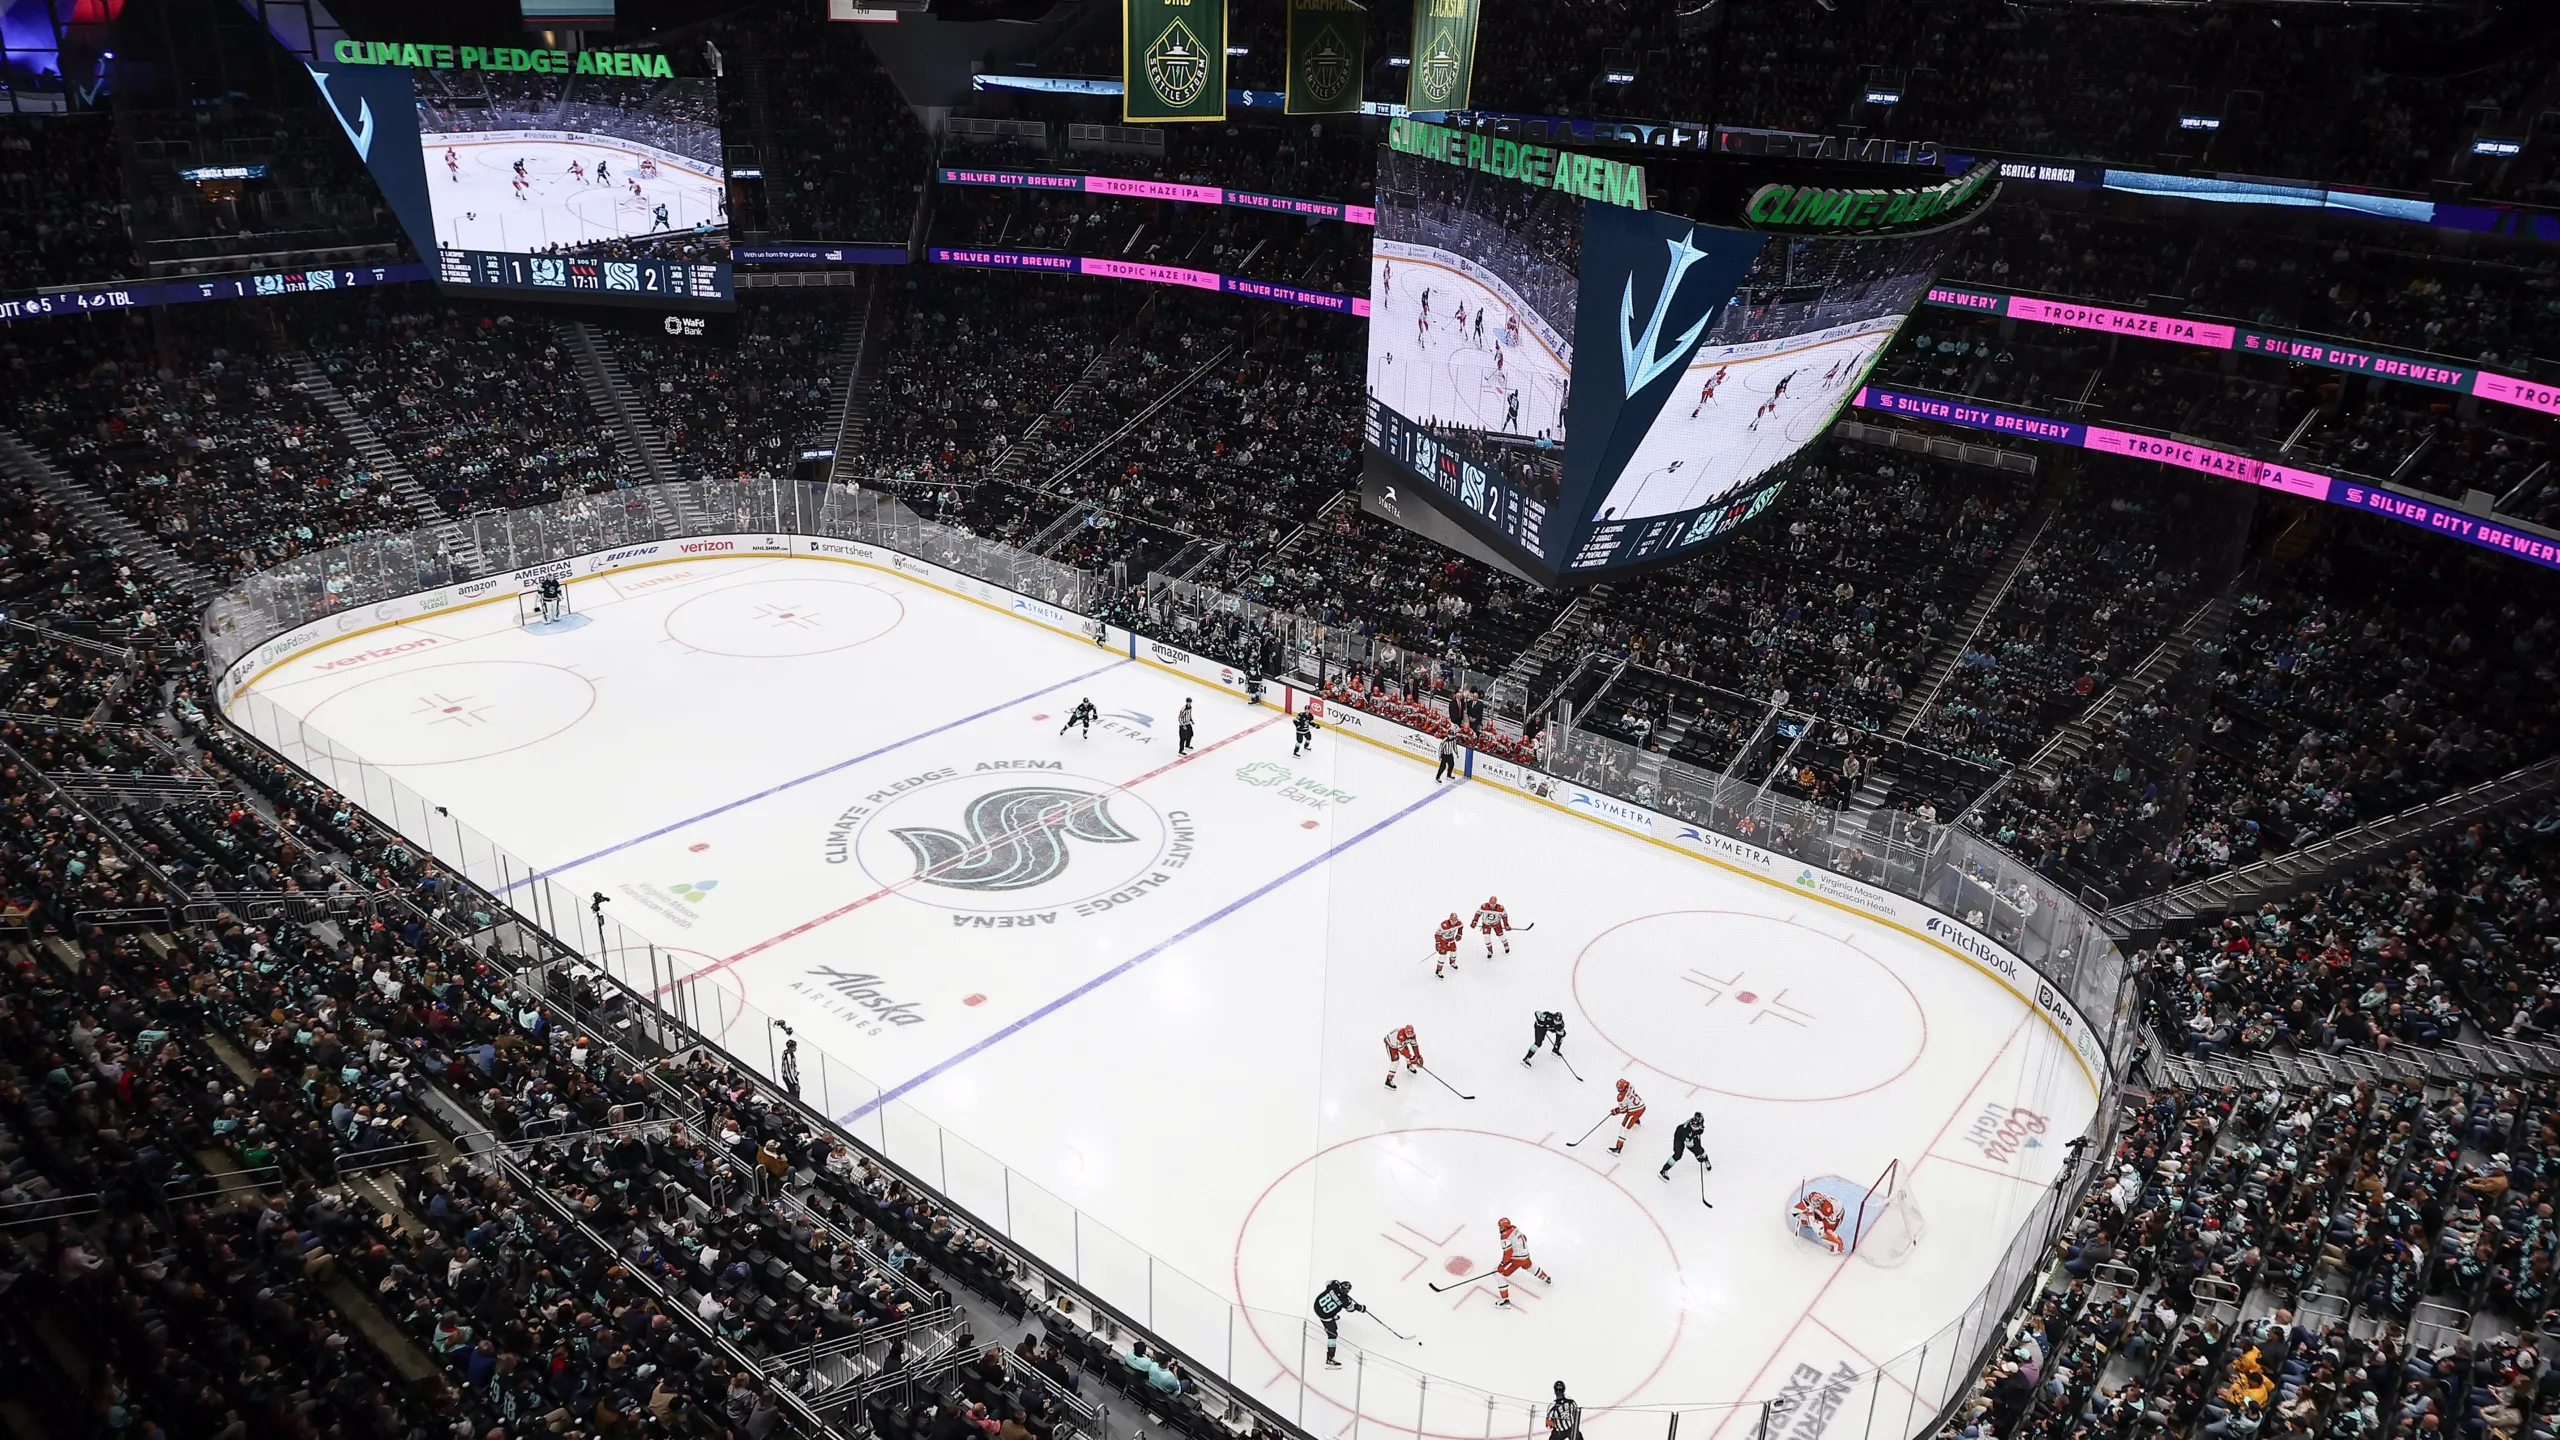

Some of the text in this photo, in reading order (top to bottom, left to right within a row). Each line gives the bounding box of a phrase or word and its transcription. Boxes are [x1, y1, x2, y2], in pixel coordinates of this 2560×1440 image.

[333, 39, 674, 79] CLIMATE PLEDGE ARENA
[1150, 58, 1206, 101] SEATTLE STORM
[1388, 117, 1645, 211] CLIMATE PLEDGE ARENA
[2000, 163, 2076, 183] SEATTLE KRAKEN
[960, 172, 1339, 217] SILVER CITY BREWERY TROPIC HAZE IPA SILVER CITY BREWERY
[1748, 182, 1888, 226] CLIMATE
[511, 261, 522, 283] 1
[590, 258, 597, 266] 17
[235, 281, 244, 296] 1
[286, 282, 307, 293] 17:11
[345, 272, 356, 286] 2
[571, 275, 599, 290] 17:11
[645, 268, 659, 291] 2
[953, 252, 1343, 308] SILVER CITY BREWERY TROPIC HAZE IPA SILVER CITY BREWERY
[40, 298, 52, 312] 5
[78, 295, 88, 308] 4
[106, 291, 134, 306] TBL
[682, 317, 705, 328] WaFd
[684, 326, 703, 336] Bank
[1927, 288, 1998, 310] BREWERY
[2043, 304, 2107, 328] TROPIC
[2112, 314, 2159, 335] HAZE
[2166, 321, 2195, 340] IPA
[2264, 338, 2323, 362] SILVER
[2328, 347, 2368, 370] CITY
[2373, 358, 2463, 387] BREWERY
[1405, 432, 1410, 462] 1
[1898, 397, 1949, 420] SILVER
[1954, 404, 1990, 427] CITY
[1995, 413, 2070, 439] BREWERY
[2128, 438, 2193, 465] TROPIC
[2199, 452, 2246, 476] HAZE
[2254, 464, 2284, 486] IPA
[2369, 492, 2426, 523] SILVER
[2433, 507, 2472, 533] CITY
[1439, 470, 1456, 497] 17:11
[1378, 494, 1401, 520] SYMETRA
[1488, 486, 1499, 522] 2
[1595, 534, 1614, 542] GUDAS
[1600, 525, 1627, 534] LACOMBE
[1665, 521, 1686, 549] 1
[606, 546, 660, 563] BOEING
[680, 539, 734, 554] verizon
[822, 542, 874, 560] smartsheet
[1590, 541, 1621, 551] COLANGELO
[1641, 539, 1656, 547] HITS
[892, 554, 930, 577] WatchGuard
[1571, 558, 1608, 568] 44 JOHNSTON
[1584, 550, 1612, 560] POEHLING
[514, 560, 572, 581] AMERICAN
[523, 569, 573, 588] EXPESS
[458, 579, 497, 595] amazon
[1027, 602, 1065, 623] SYMETRA
[313, 636, 438, 671] verizon
[1152, 642, 1190, 664] amazon
[241, 660, 255, 677] App
[1221, 672, 1234, 680] PEPSI
[1238, 677, 1267, 695] PSI
[1326, 706, 1362, 728] TOYOTA
[1482, 763, 1516, 779] KRAKEN
[1277, 786, 1330, 810] Bank
[1296, 776, 1357, 804] WaFd
[825, 758, 1064, 865] CLIMATE PLEDGE ARENA
[1594, 798, 1653, 827] SYMETRA
[1704, 834, 1771, 866] SYMETRA
[952, 809, 1195, 929] CLIMATE PLEDGE ARENA
[638, 880, 700, 920] Virginia Mason
[1818, 883, 1896, 917] Franciscan Health
[1820, 874, 1884, 903] Virginia Mason
[617, 883, 694, 930] Franciscan Health
[1940, 922, 2018, 981] PitchBook
[804, 964, 926, 1027] Alaska
[787, 981, 883, 1037] AIRLINES
[2052, 1000, 2073, 1027] App
[1963, 1102, 2010, 1149] LIGHT
[1984, 1107, 2050, 1165] Coors
[1318, 1292, 1338, 1314] 89
